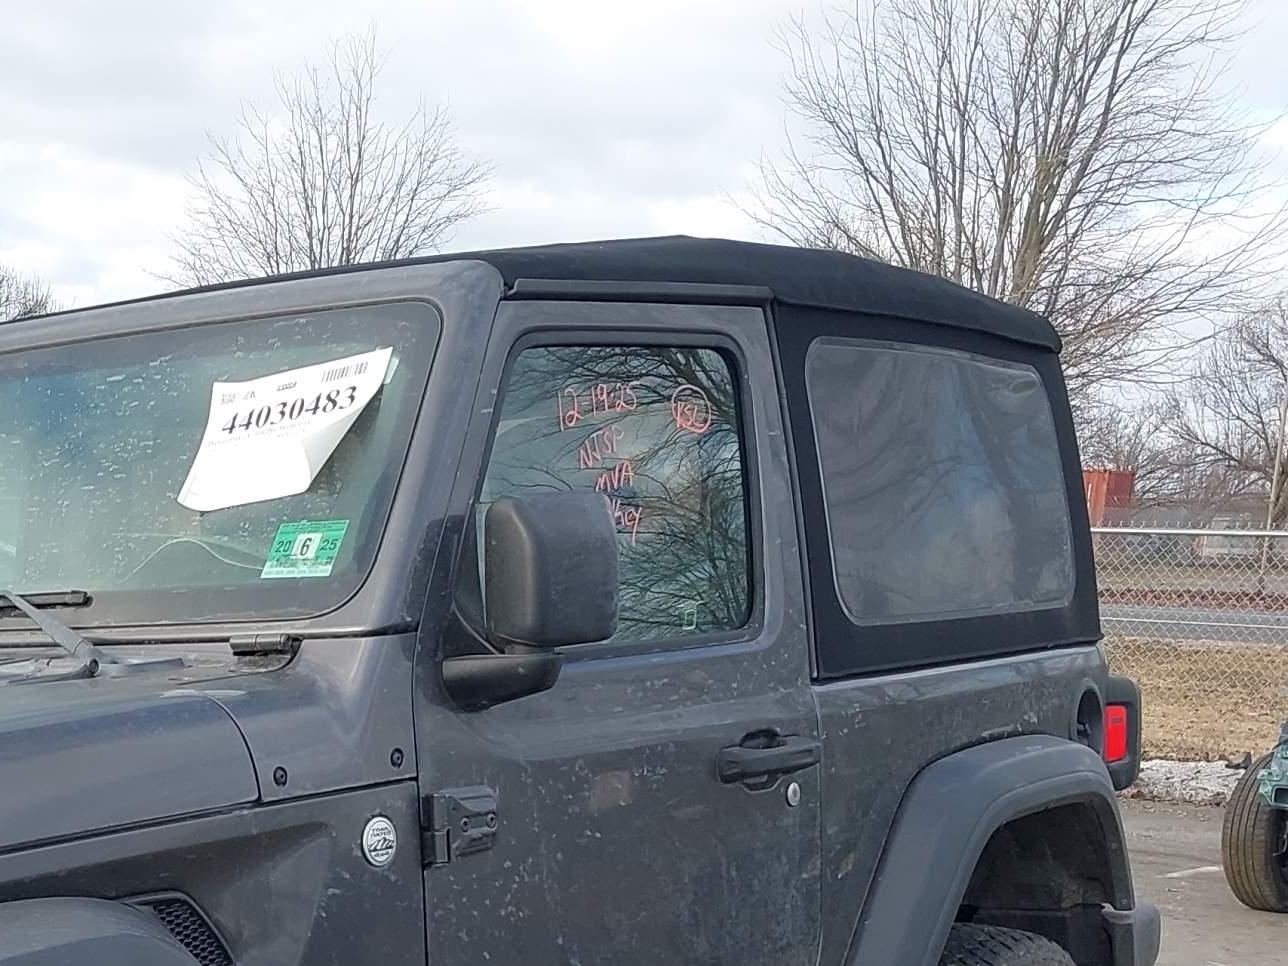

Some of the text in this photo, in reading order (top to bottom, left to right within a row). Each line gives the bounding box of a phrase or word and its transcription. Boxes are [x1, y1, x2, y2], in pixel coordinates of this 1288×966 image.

[222, 385, 357, 434] 44030483
[275, 537, 338, 556] 20 6 25
